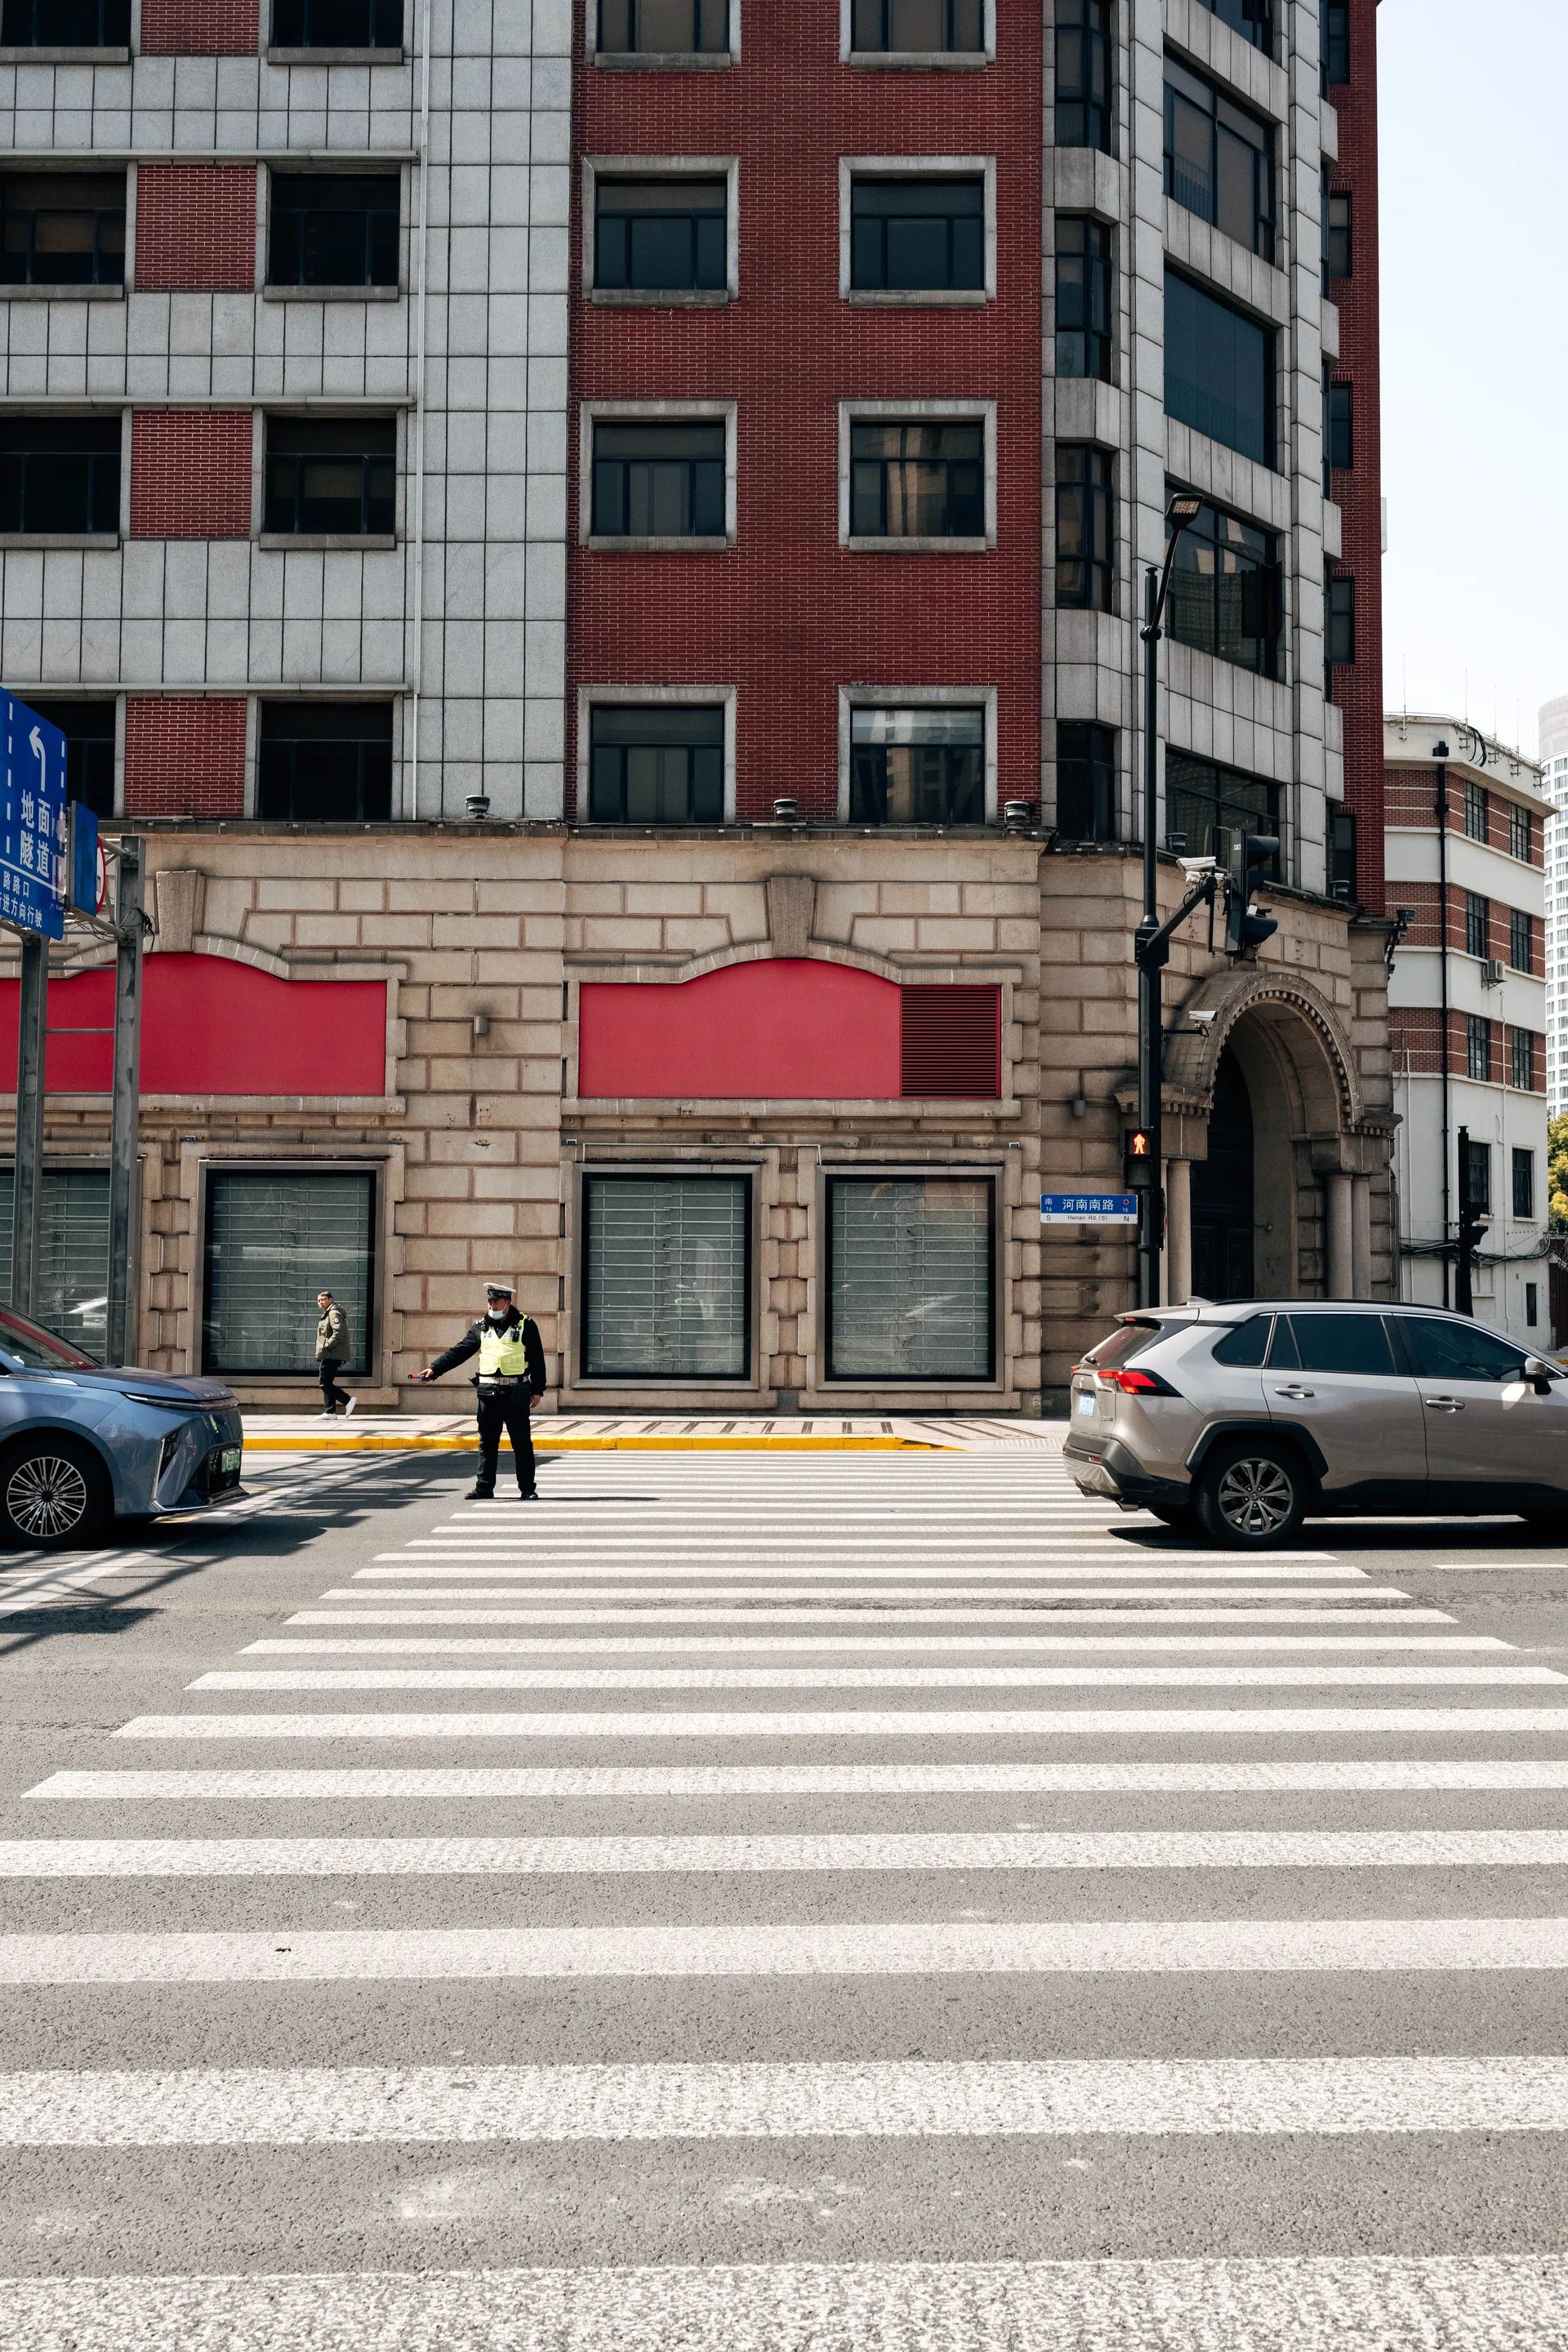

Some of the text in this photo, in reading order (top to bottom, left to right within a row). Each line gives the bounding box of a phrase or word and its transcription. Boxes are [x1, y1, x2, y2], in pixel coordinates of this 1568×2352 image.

[20, 789, 51, 838] 地面
[20, 830, 50, 879] 隧道
[2, 870, 29, 898] 路路口
[1045, 1197, 1053, 1205] 南
[1062, 1198, 1114, 1211] 河南南路
